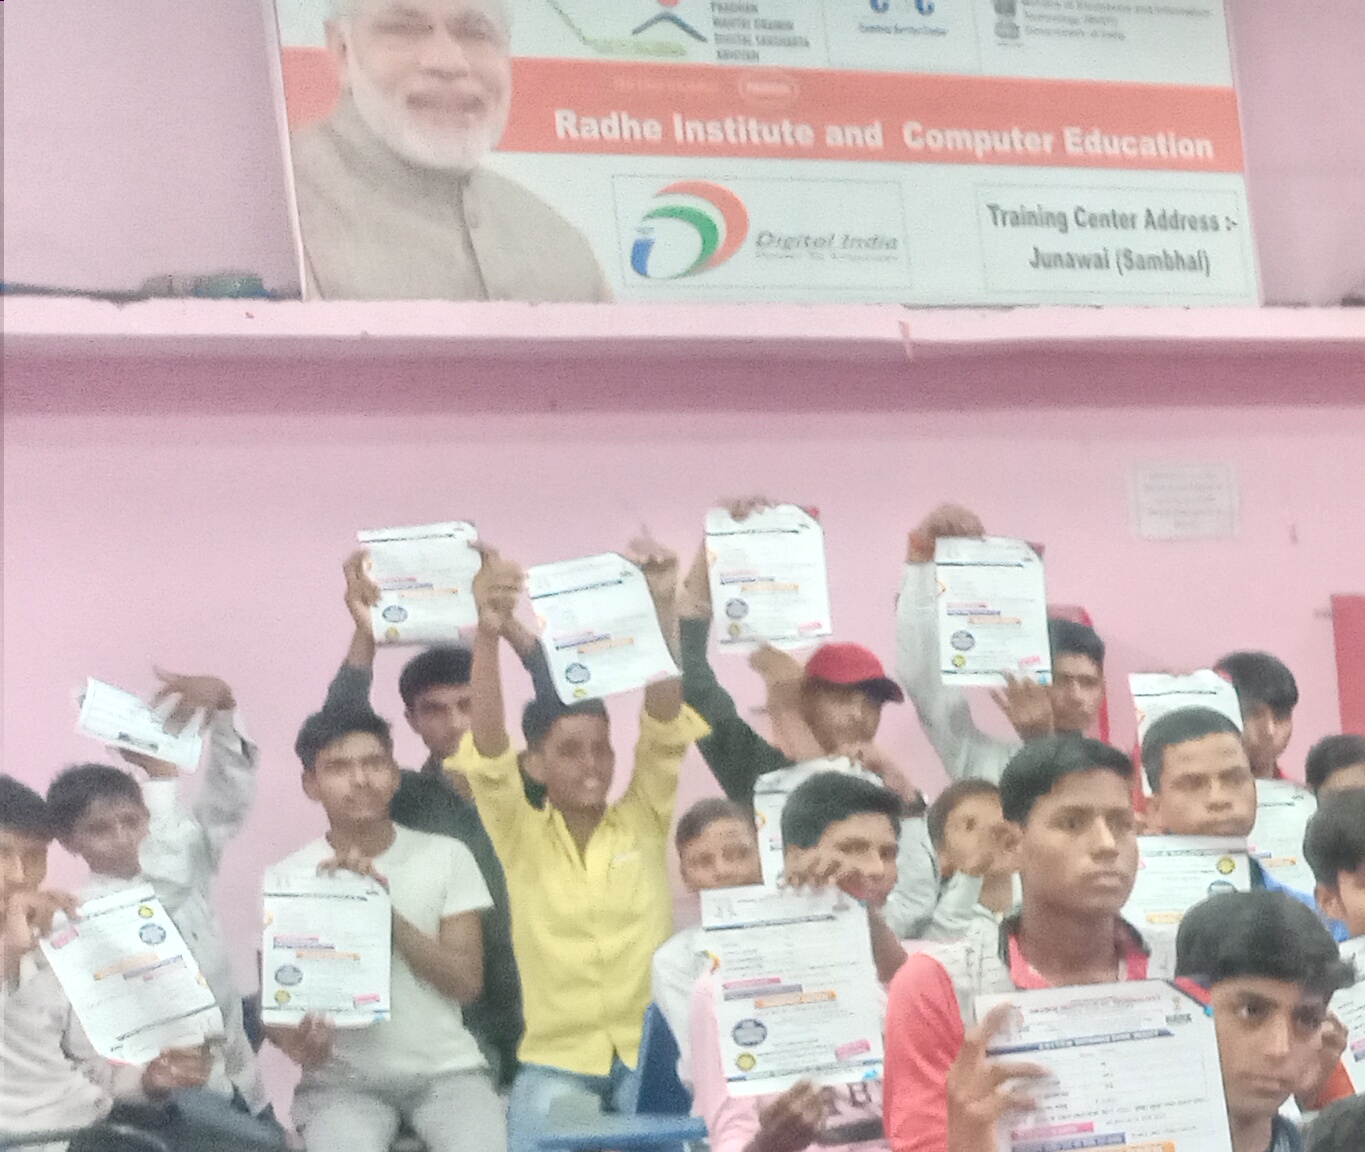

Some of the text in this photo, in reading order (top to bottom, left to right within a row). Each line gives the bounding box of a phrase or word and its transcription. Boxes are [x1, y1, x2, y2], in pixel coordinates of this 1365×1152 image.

[555, 109, 1214, 159] Radhe Institute and Computer Education
[986, 203, 1068, 233] Training
[1073, 205, 1138, 230] Center
[1144, 207, 1220, 232] Address
